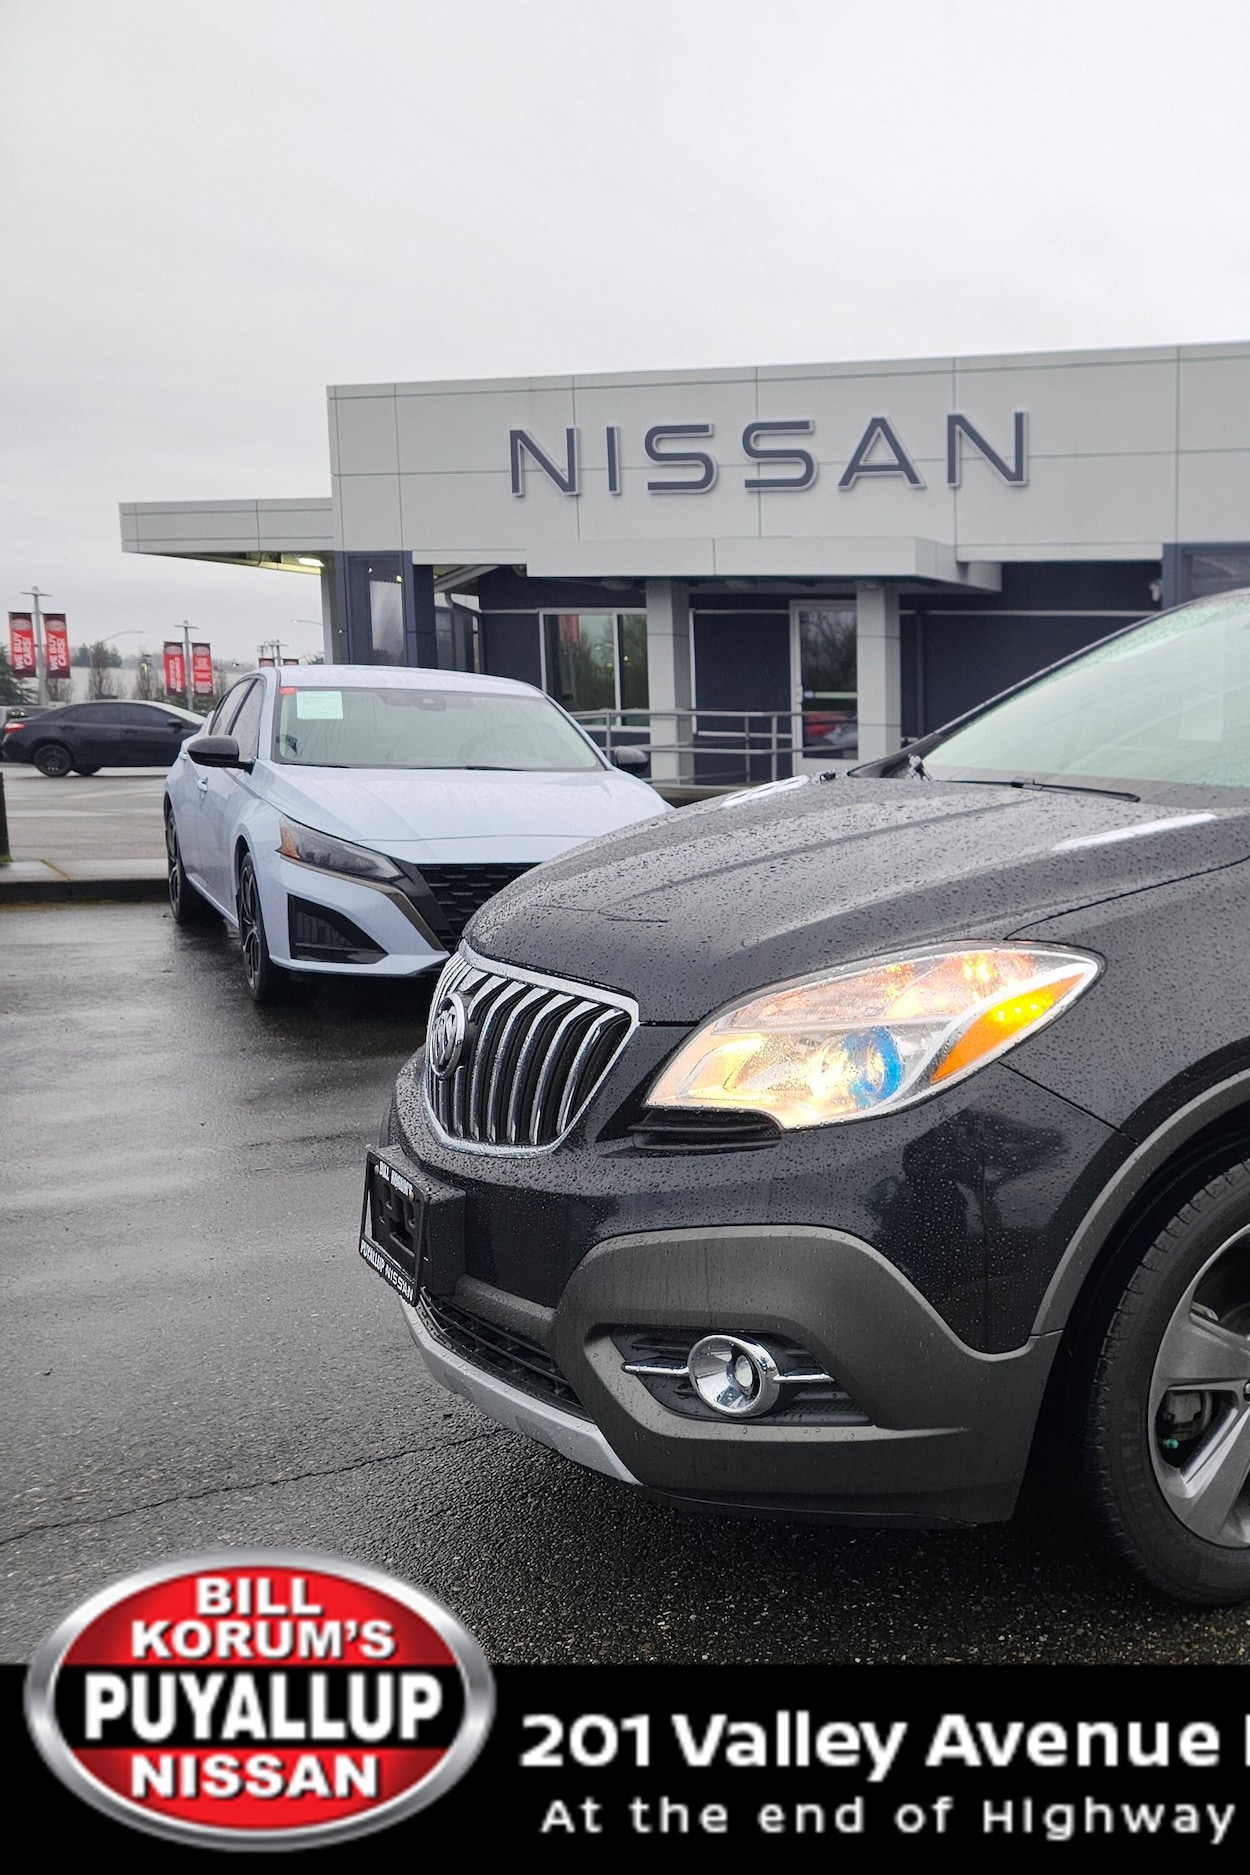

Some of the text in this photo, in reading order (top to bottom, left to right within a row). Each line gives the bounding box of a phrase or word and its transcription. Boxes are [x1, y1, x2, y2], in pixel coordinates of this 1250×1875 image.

[508, 411, 1030, 497] NISSAN
[360, 1239, 414, 1302] PUYALLUP NISSAN
